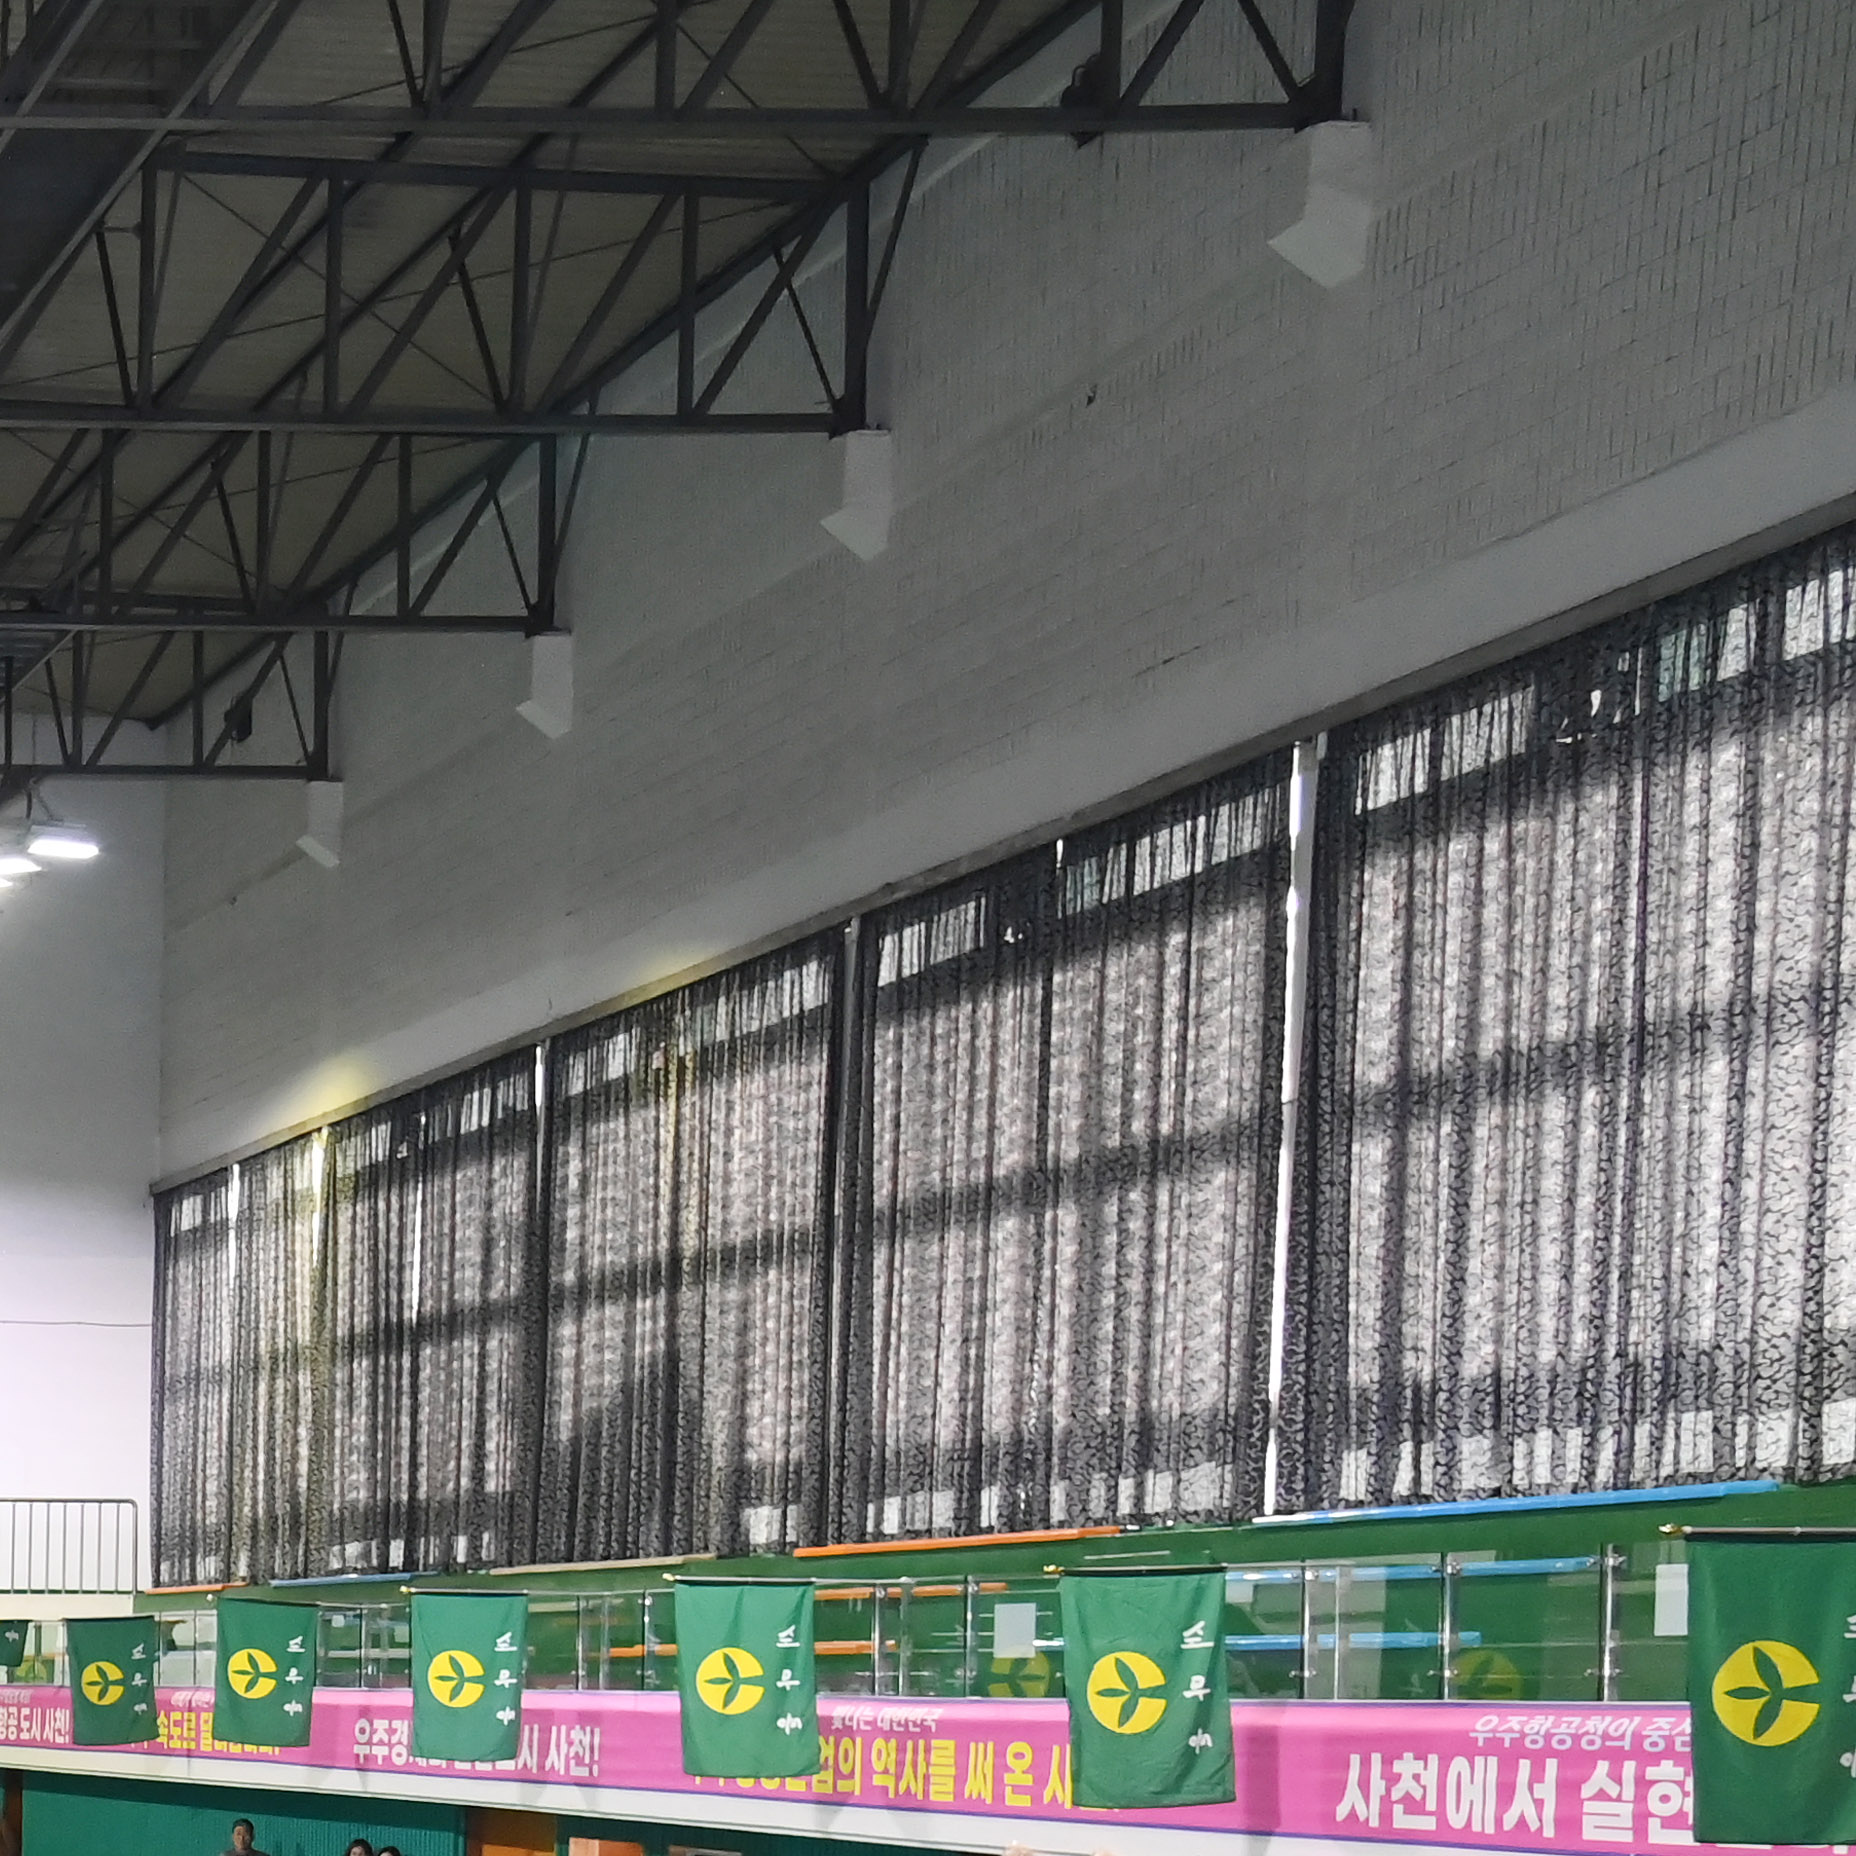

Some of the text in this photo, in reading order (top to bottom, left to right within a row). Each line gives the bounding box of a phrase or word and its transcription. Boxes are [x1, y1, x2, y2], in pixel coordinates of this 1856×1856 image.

[19, 1706, 41, 1742] 도시
[43, 1707, 70, 1744] 사천!
[877, 1706, 943, 1733] 대한민국
[1470, 1715, 1640, 1751] 우주항공청의
[545, 1724, 600, 1777] 사천!
[871, 1737, 956, 1801] 역사를
[964, 1741, 994, 1804] 써
[1003, 1741, 1033, 1806] 온
[1336, 1753, 1558, 1838] 사천에서
